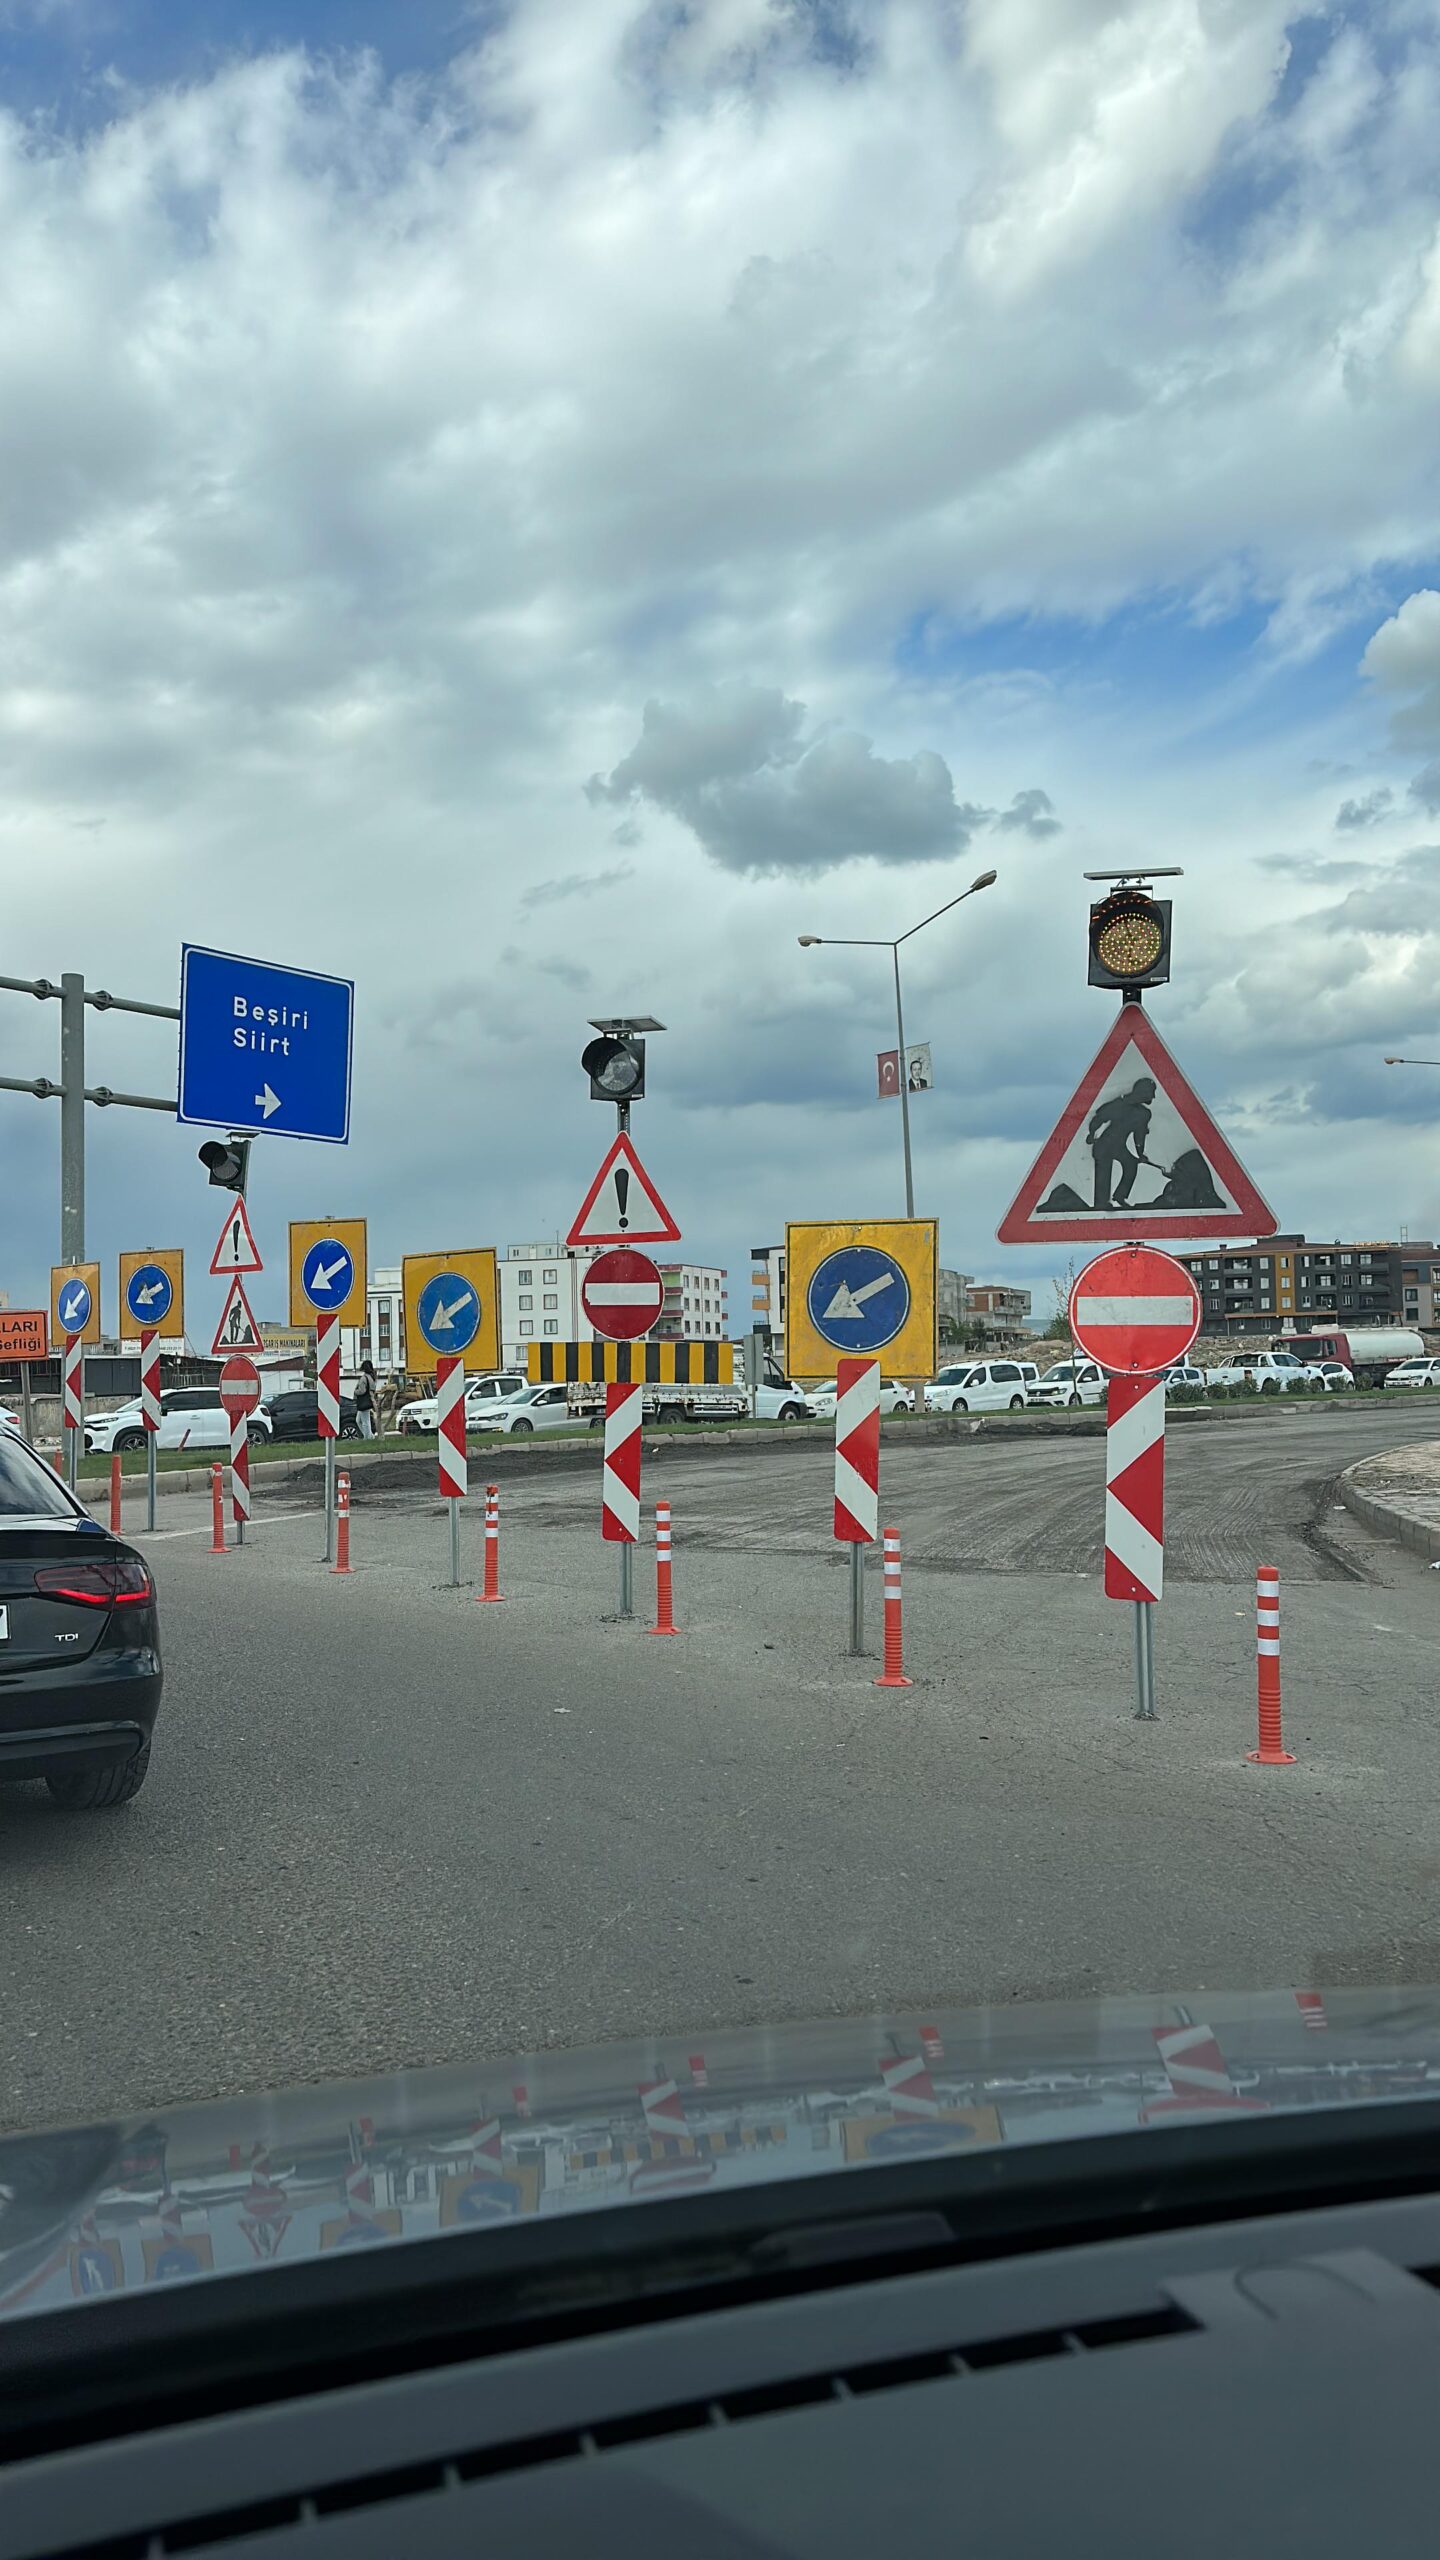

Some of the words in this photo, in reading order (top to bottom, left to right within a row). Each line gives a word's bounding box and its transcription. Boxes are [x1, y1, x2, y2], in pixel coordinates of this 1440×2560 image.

[233, 996, 308, 1030] Beşiri
[232, 1027, 290, 1056] Siirt
[0, 1320, 38, 1333] LARI
[54, 1632, 79, 1642] TDI
